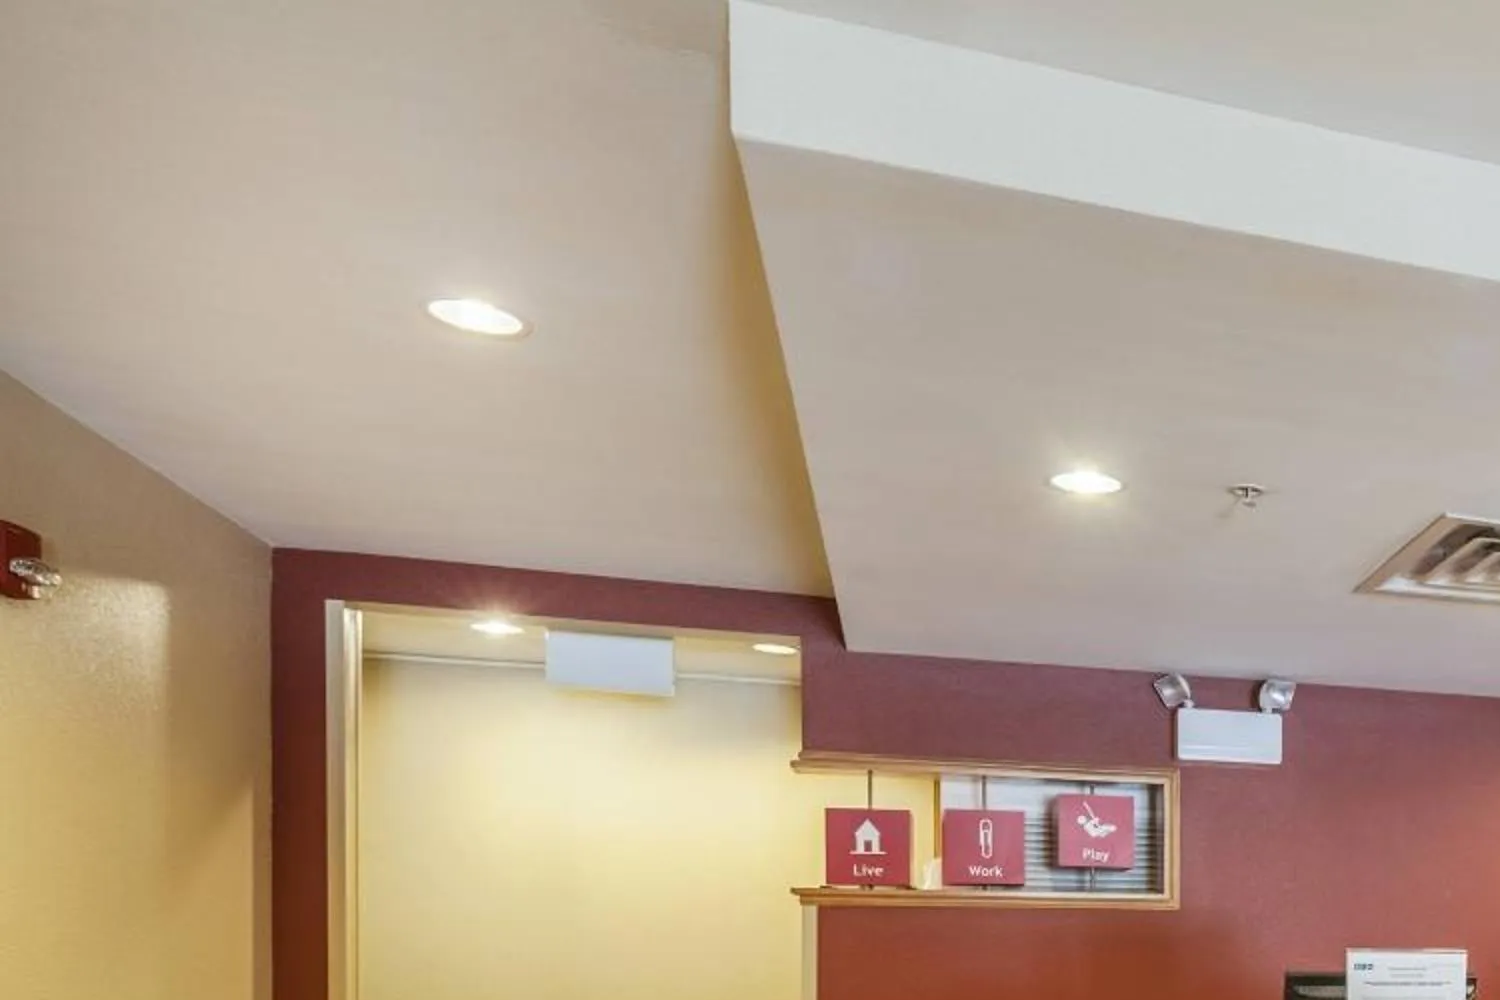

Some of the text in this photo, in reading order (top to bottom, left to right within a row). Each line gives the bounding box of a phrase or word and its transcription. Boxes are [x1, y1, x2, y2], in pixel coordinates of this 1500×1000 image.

[1082, 849, 1110, 863] Play
[853, 864, 885, 877] Live
[968, 864, 1003, 877] Work
